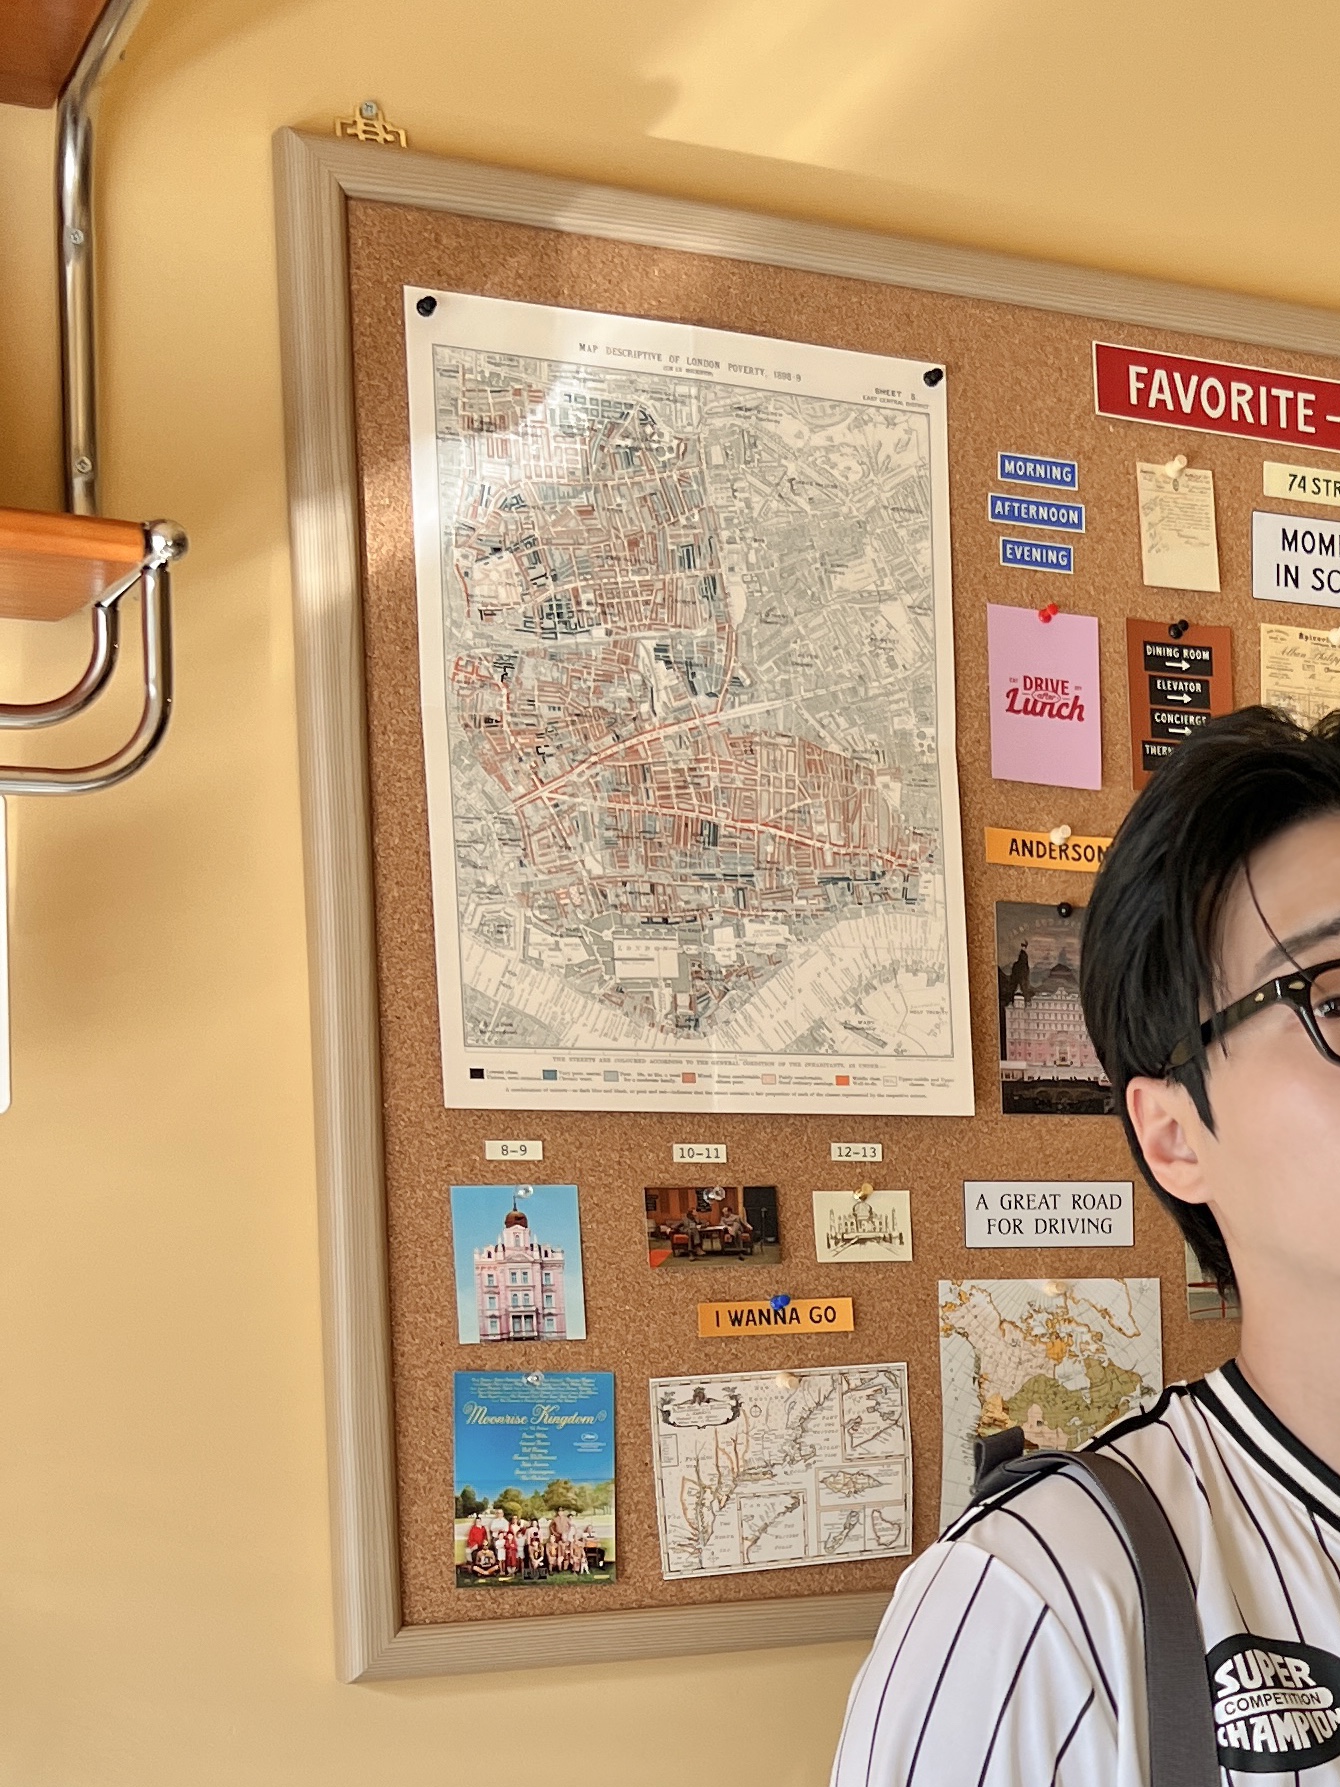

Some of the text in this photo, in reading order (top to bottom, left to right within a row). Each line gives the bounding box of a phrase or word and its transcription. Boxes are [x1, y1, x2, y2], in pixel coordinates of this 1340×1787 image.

[579, 343, 598, 353] MAP
[606, 346, 662, 362] DESCRIPTIVE
[669, 353, 680, 363] OF
[686, 356, 720, 370] LONDON
[1004, 459, 1072, 482] MORNING
[1288, 474, 1307, 493] 74
[994, 501, 1079, 524] AFTERNOON
[1006, 543, 1068, 566] EVENING
[1276, 563, 1299, 589] IN
[1146, 645, 1210, 661] DINING ROOM
[1023, 675, 1070, 695] DRIVE
[1156, 679, 1202, 692] ELEVATOR
[1006, 687, 1085, 722] Lunch
[1154, 712, 1207, 726] CONCIERGE
[1008, 838, 1111, 862] ANDERSON
[501, 1145, 528, 1157] 8-9
[678, 1147, 721, 1160] 10-11
[836, 1146, 877, 1160] 12-13
[976, 1194, 1123, 1211] A GREAT ROAD
[986, 1218, 1113, 1236] FOR DRIVING
[715, 1306, 837, 1328] I WANNA GO
[462, 1401, 607, 1430] Moonrise Kingdom
[1214, 1649, 1317, 1698] SUPER
[1224, 1692, 1321, 1715] COMPETITION
